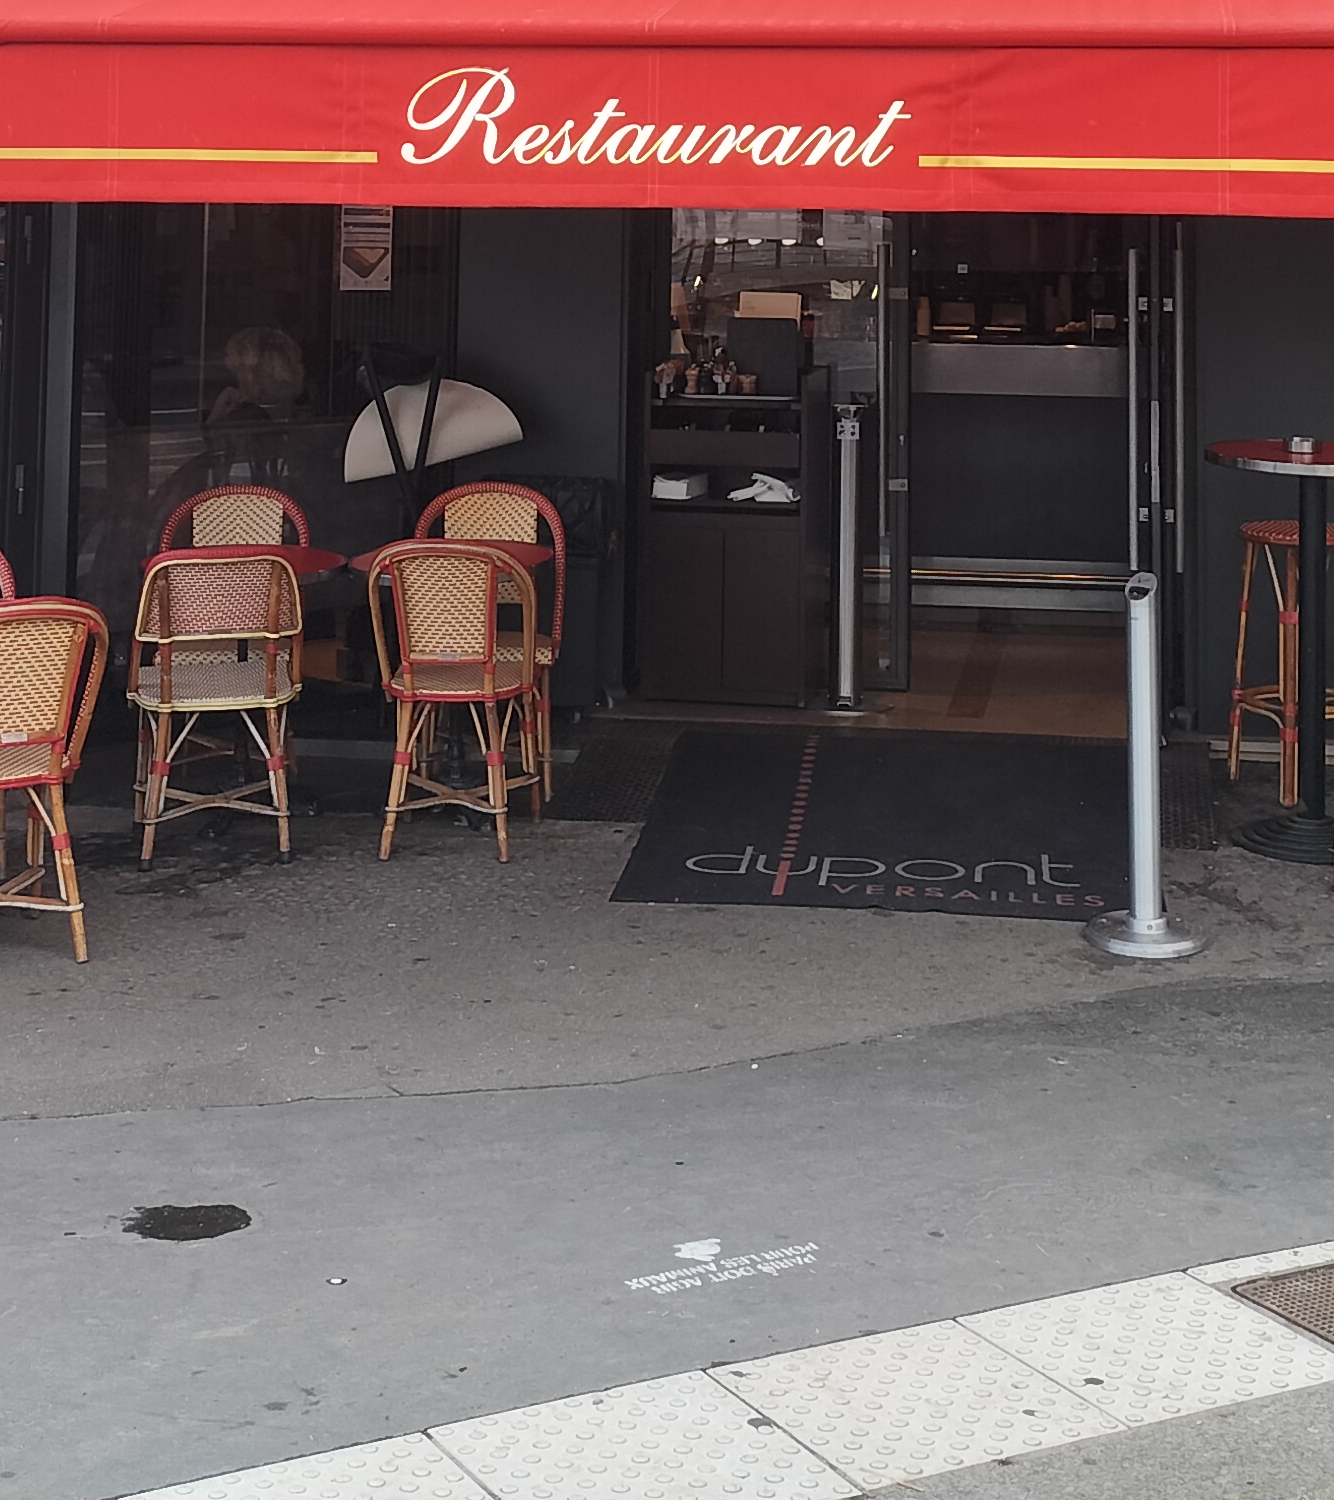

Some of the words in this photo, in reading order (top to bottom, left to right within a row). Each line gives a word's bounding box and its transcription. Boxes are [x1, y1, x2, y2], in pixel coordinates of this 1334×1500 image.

[399, 66, 913, 168] Restaurant
[685, 844, 1082, 892] dupont
[830, 882, 1106, 909] VERSAILLES
[719, 1254, 762, 1269] LES
[760, 1242, 819, 1261] POUR
[623, 1262, 717, 1290] ANIMAUX
[650, 1276, 703, 1295] AGIR
[708, 1265, 758, 1284] DOIT
